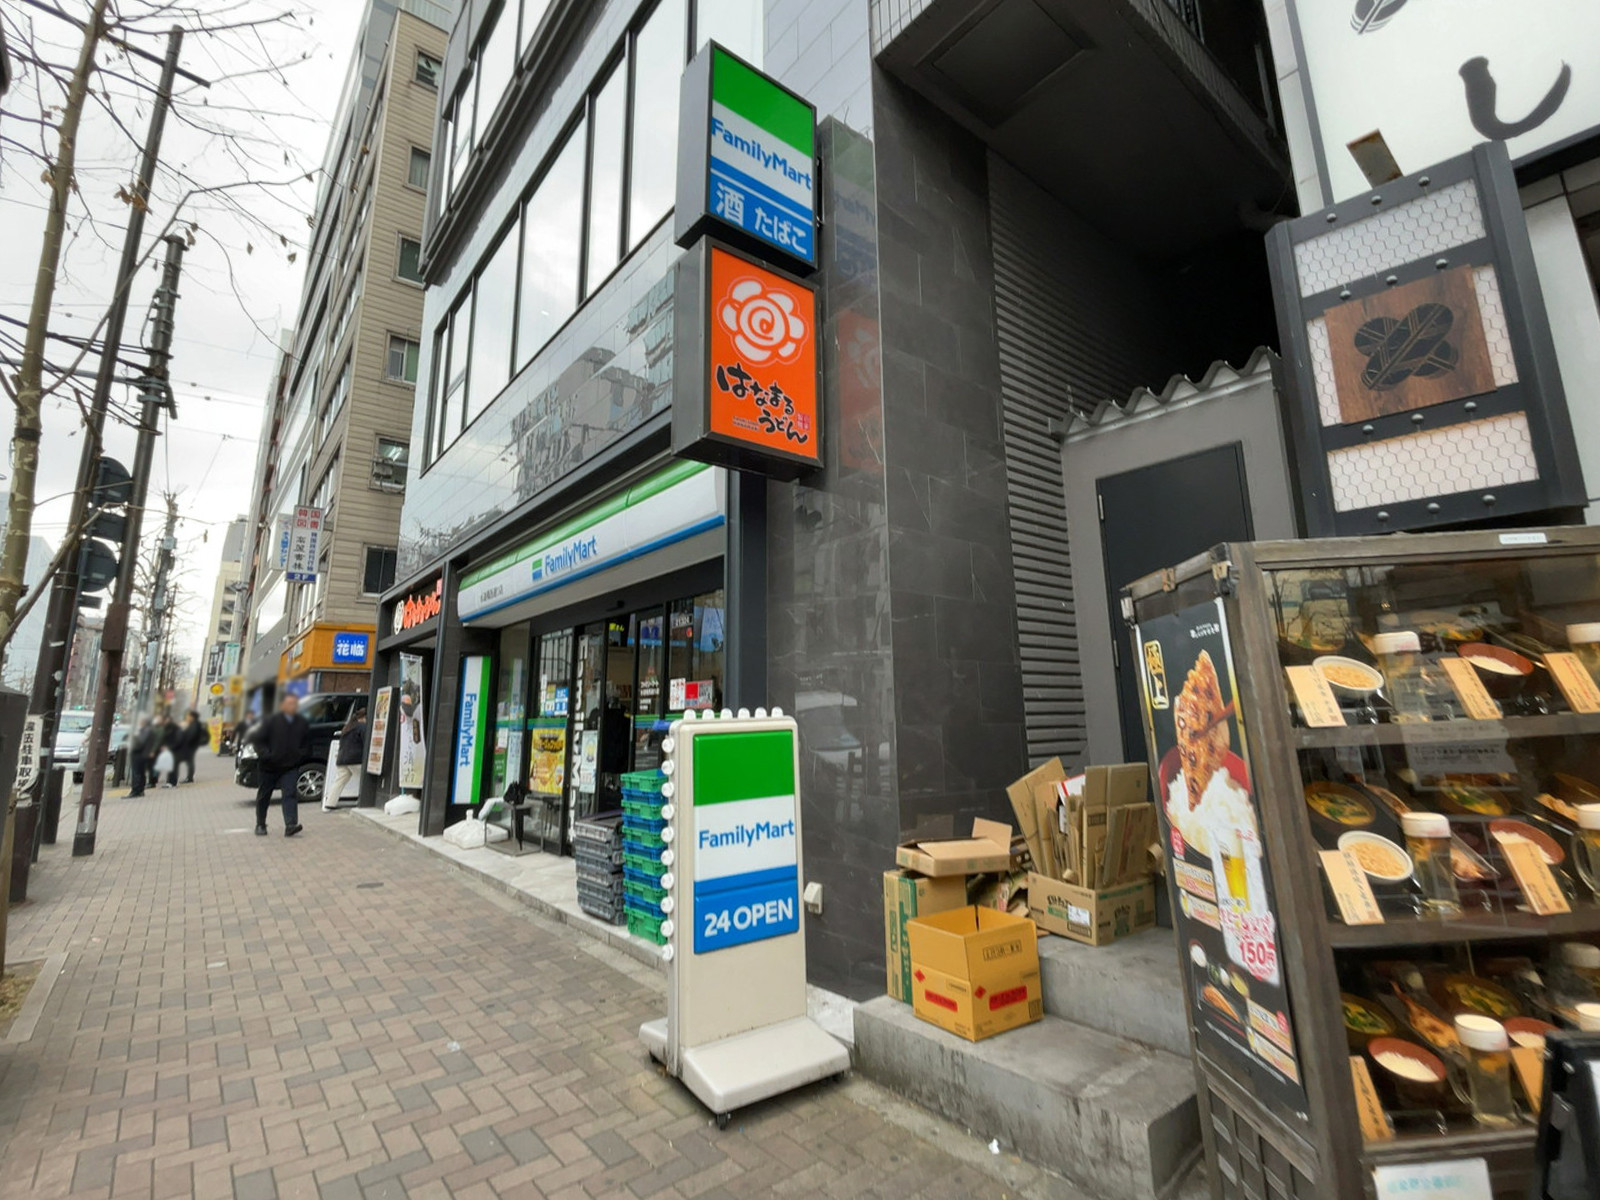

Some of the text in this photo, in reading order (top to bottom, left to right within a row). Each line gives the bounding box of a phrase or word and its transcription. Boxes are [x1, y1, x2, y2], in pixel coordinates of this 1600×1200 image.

[1457, 56, 1572, 142] し
[710, 117, 813, 191] FamilyMart
[715, 182, 807, 255] 酒 たばこ
[715, 362, 796, 416] はなまる
[758, 409, 808, 444] うどん
[545, 535, 598, 577] FamilyMart
[459, 692, 478, 768] FamilyMart
[698, 819, 795, 850] FamilyMart
